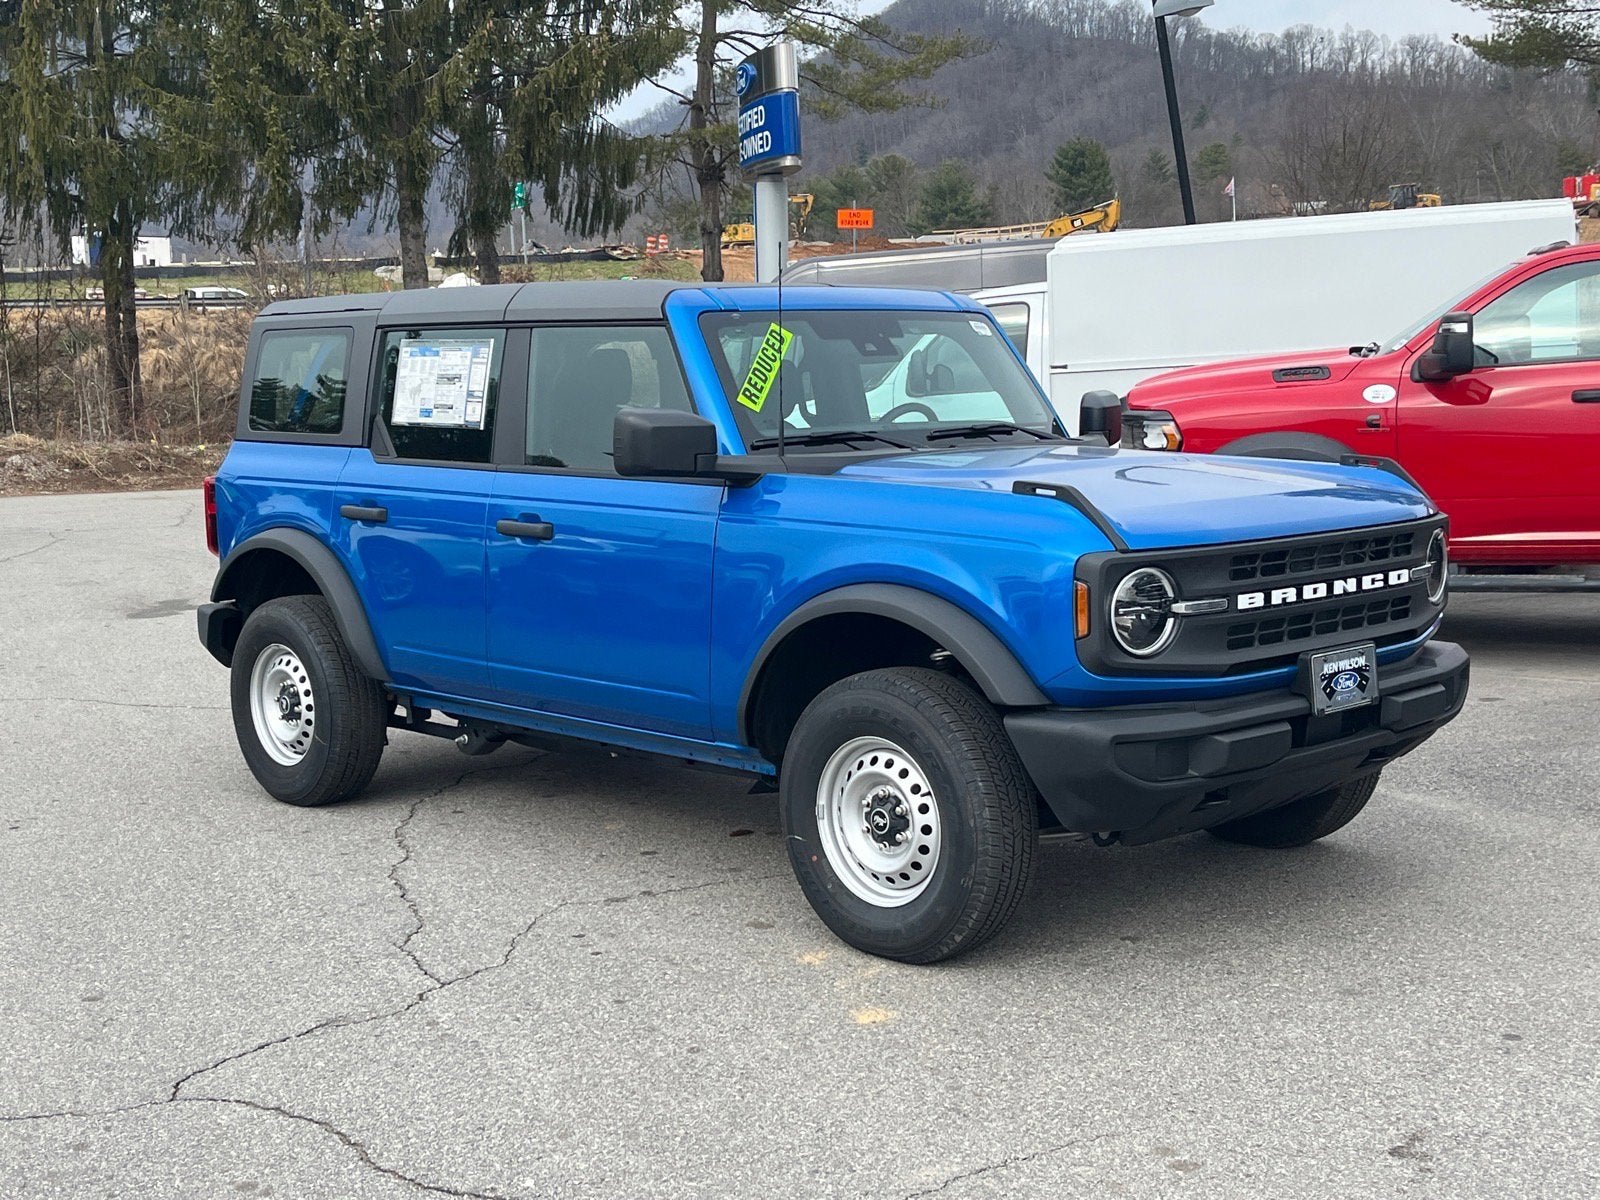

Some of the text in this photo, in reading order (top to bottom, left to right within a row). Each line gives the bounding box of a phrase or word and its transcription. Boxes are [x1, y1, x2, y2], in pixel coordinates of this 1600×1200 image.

[848, 211, 861, 219] END
[741, 328, 785, 405] REDUCED
[1237, 569, 1410, 610] BRONCO
[1323, 655, 1366, 675] KEN WILSON
[1337, 674, 1355, 689] Ford
